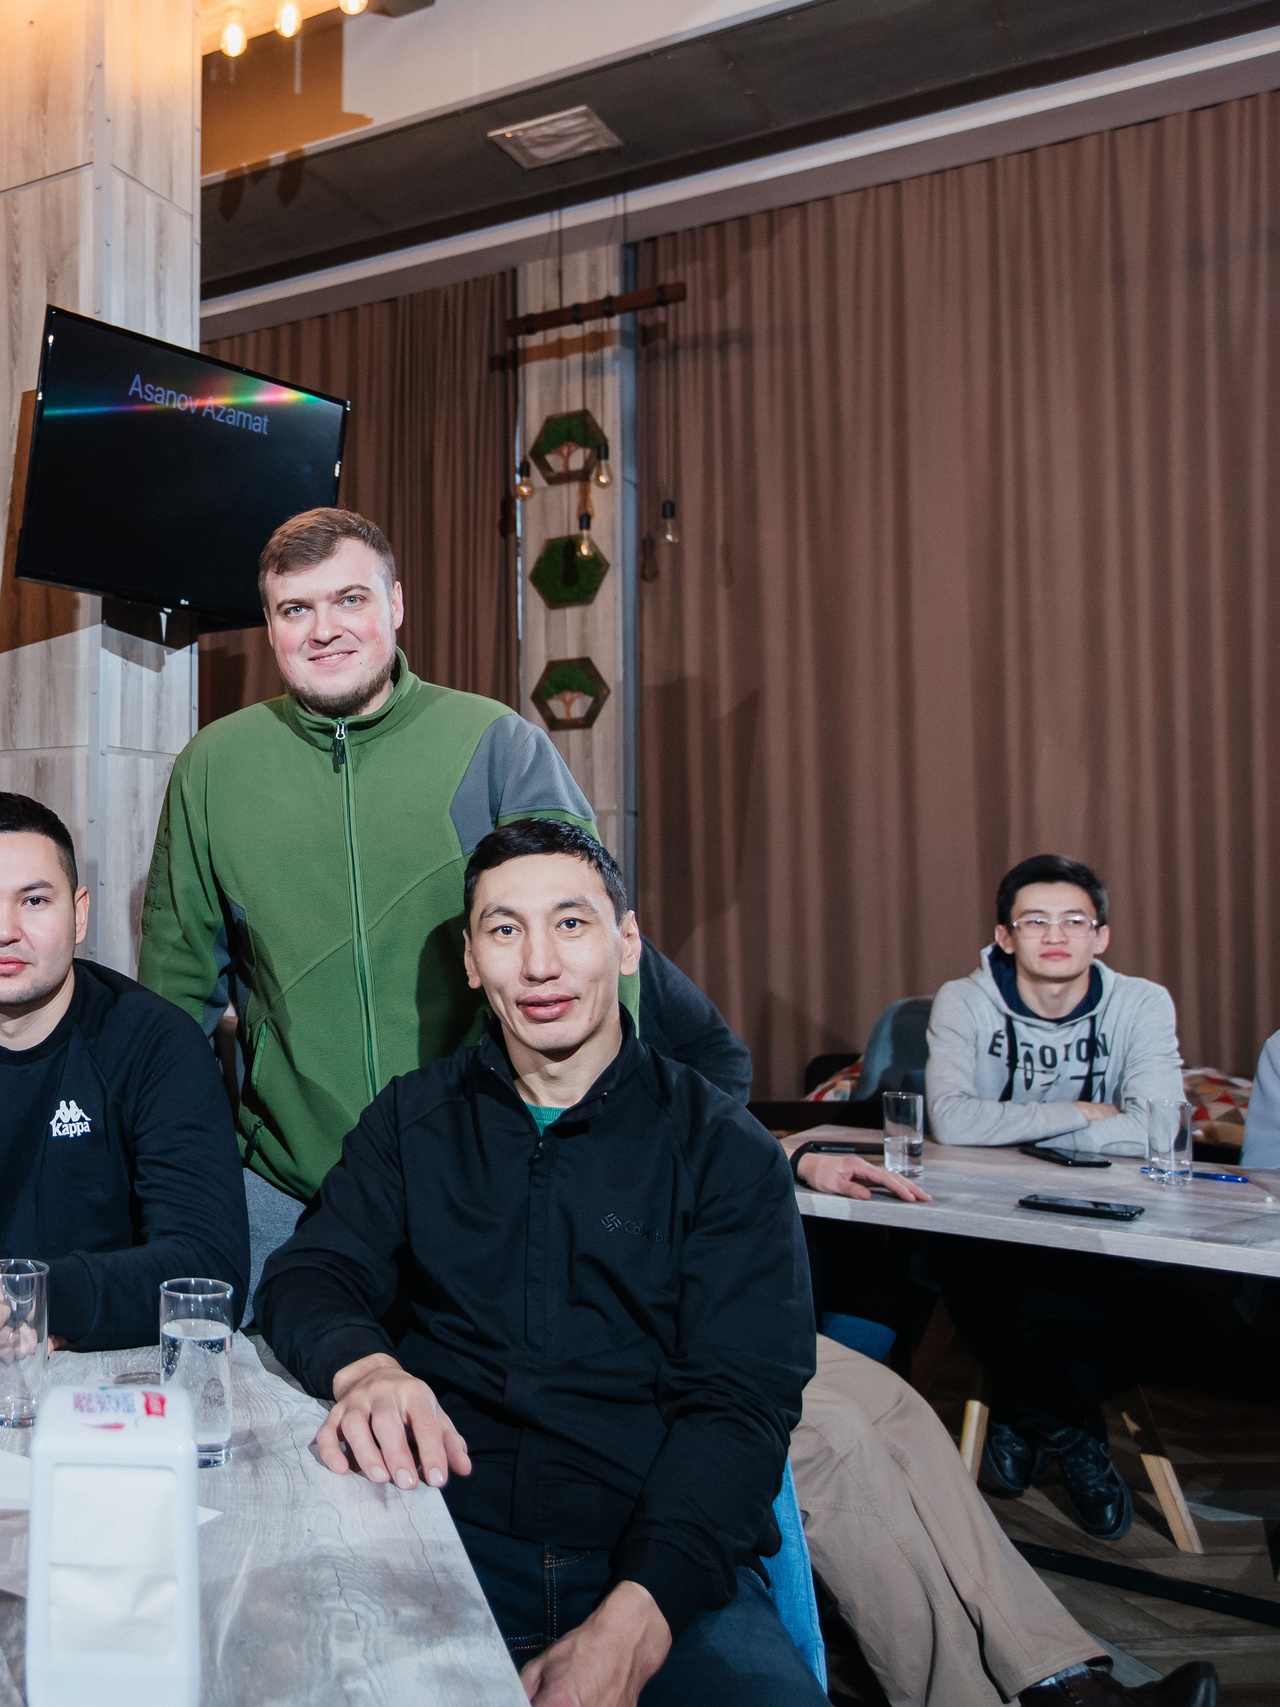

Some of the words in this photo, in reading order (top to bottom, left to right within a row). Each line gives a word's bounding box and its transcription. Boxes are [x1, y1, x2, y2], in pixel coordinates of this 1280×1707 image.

[128, 373, 199, 415] Asanov
[202, 395, 269, 436] Azamat
[51, 1121, 91, 1138] Kappa
